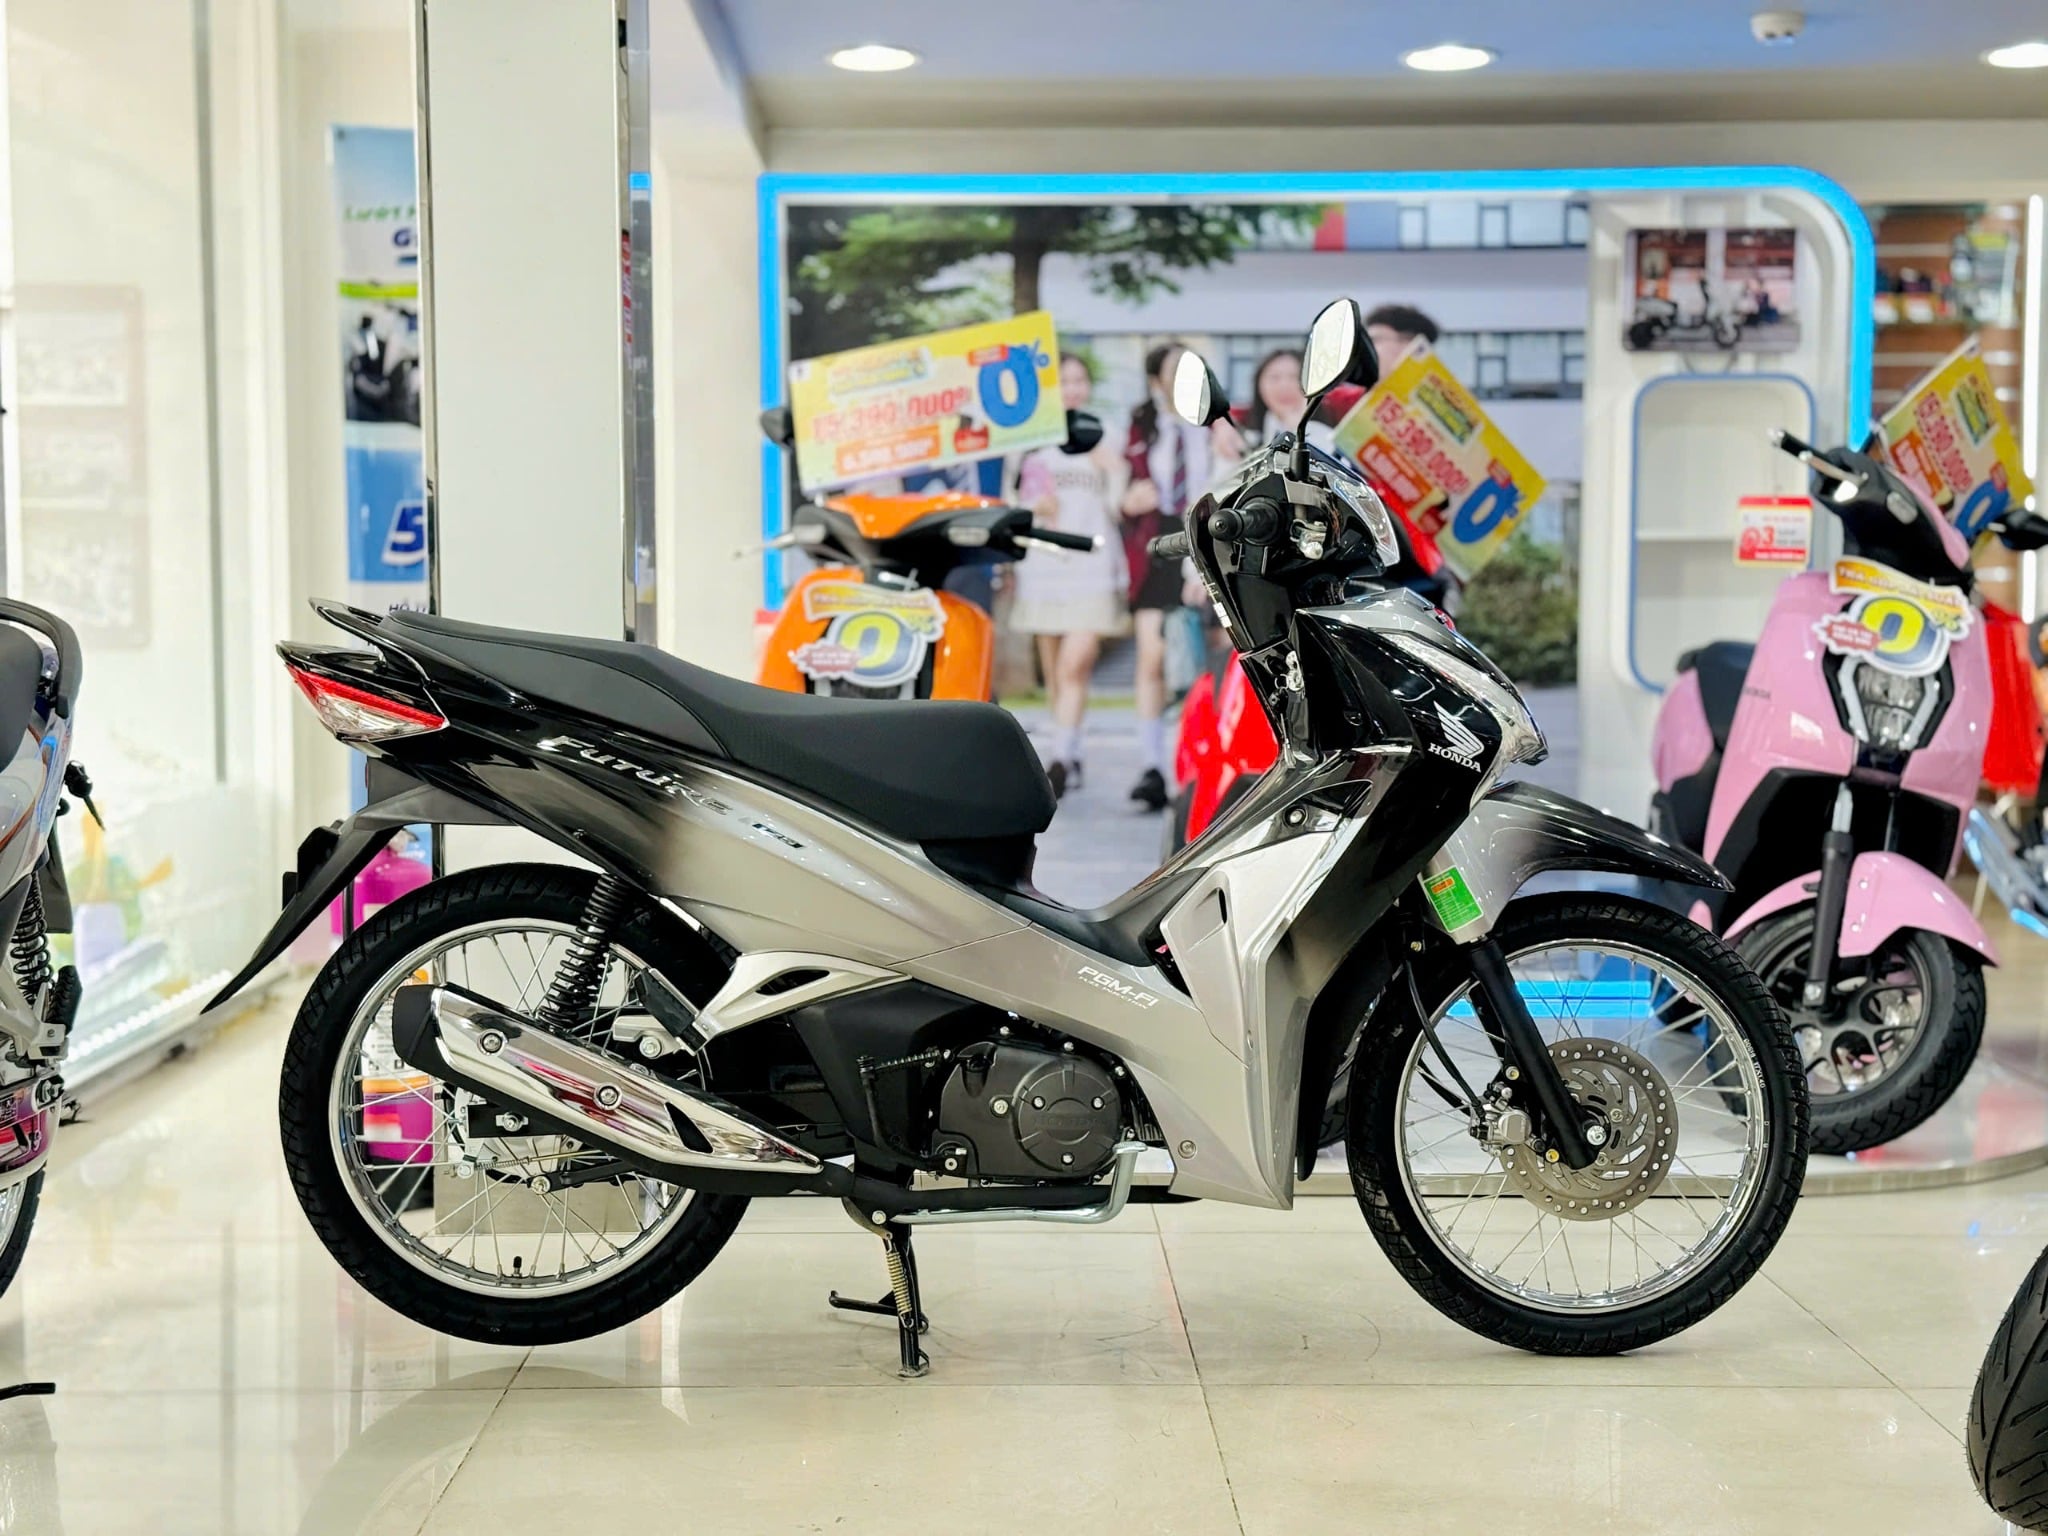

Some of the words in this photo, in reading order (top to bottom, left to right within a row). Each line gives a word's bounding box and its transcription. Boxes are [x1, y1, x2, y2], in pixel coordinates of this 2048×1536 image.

[979, 340, 1050, 427] 0%
[1428, 742, 1481, 773] HONDA
[1077, 965, 1159, 1007] PGM-FI
